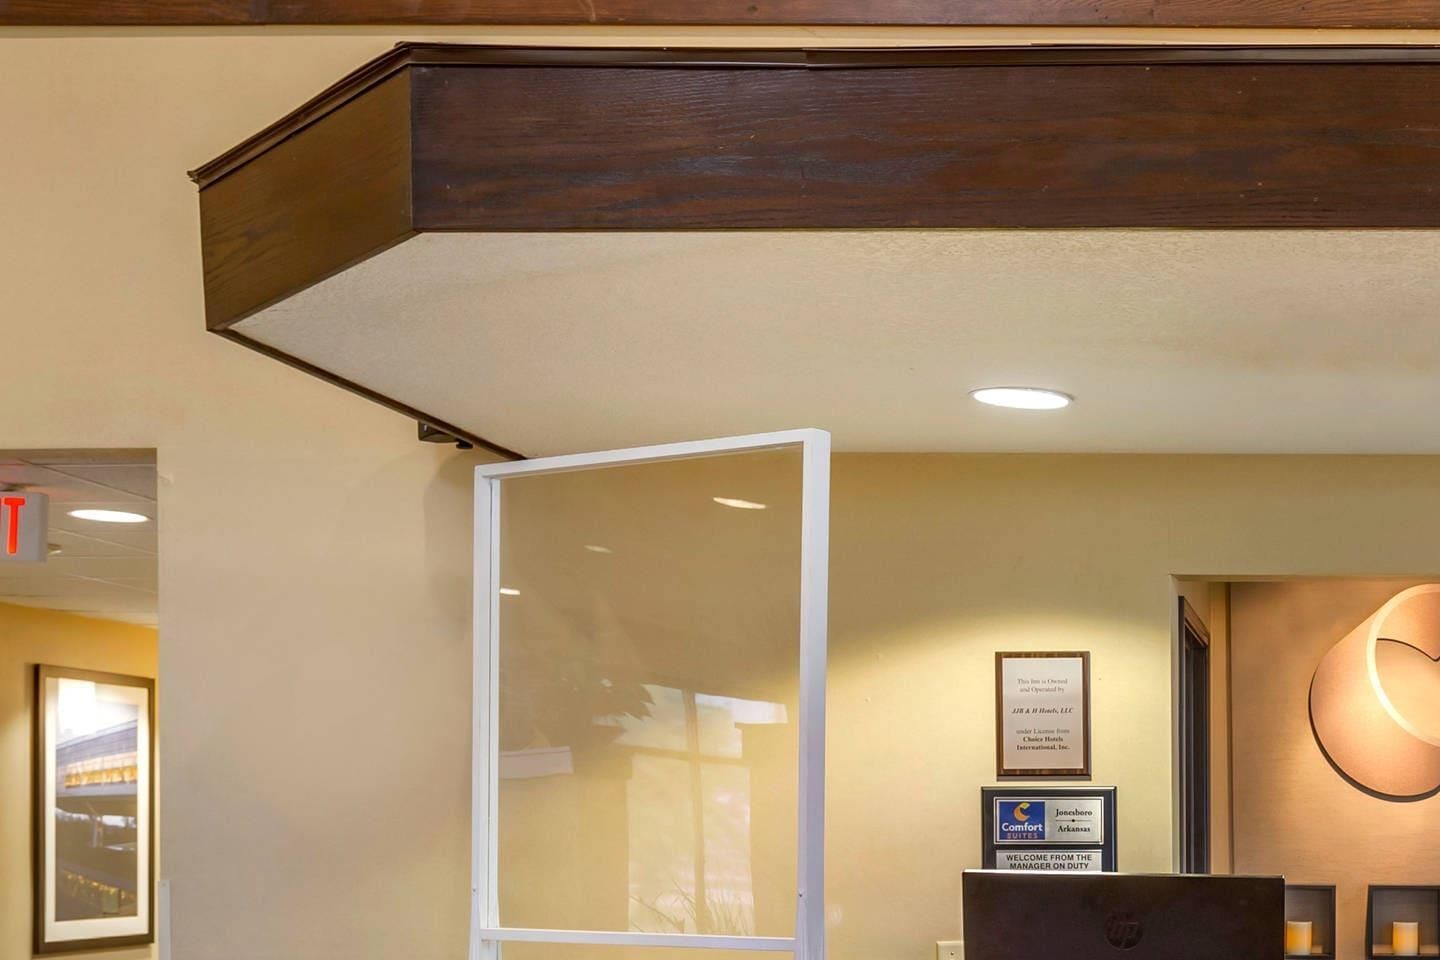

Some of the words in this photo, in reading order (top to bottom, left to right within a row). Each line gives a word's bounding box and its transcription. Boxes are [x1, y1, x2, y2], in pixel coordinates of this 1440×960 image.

[1031, 686, 1057, 694] Operated
[1033, 727, 1055, 735] License
[1055, 808, 1093, 818] Jonesboro
[1001, 822, 1043, 832] Comfort
[1057, 825, 1091, 833] Arkansas
[1006, 854, 1049, 862] WELCOME
[1050, 854, 1075, 862] FROM
[1076, 854, 1093, 862] THE
[1009, 862, 1051, 870] MANAGER
[1052, 862, 1066, 870] ON
[1067, 862, 1090, 870] DUTY
